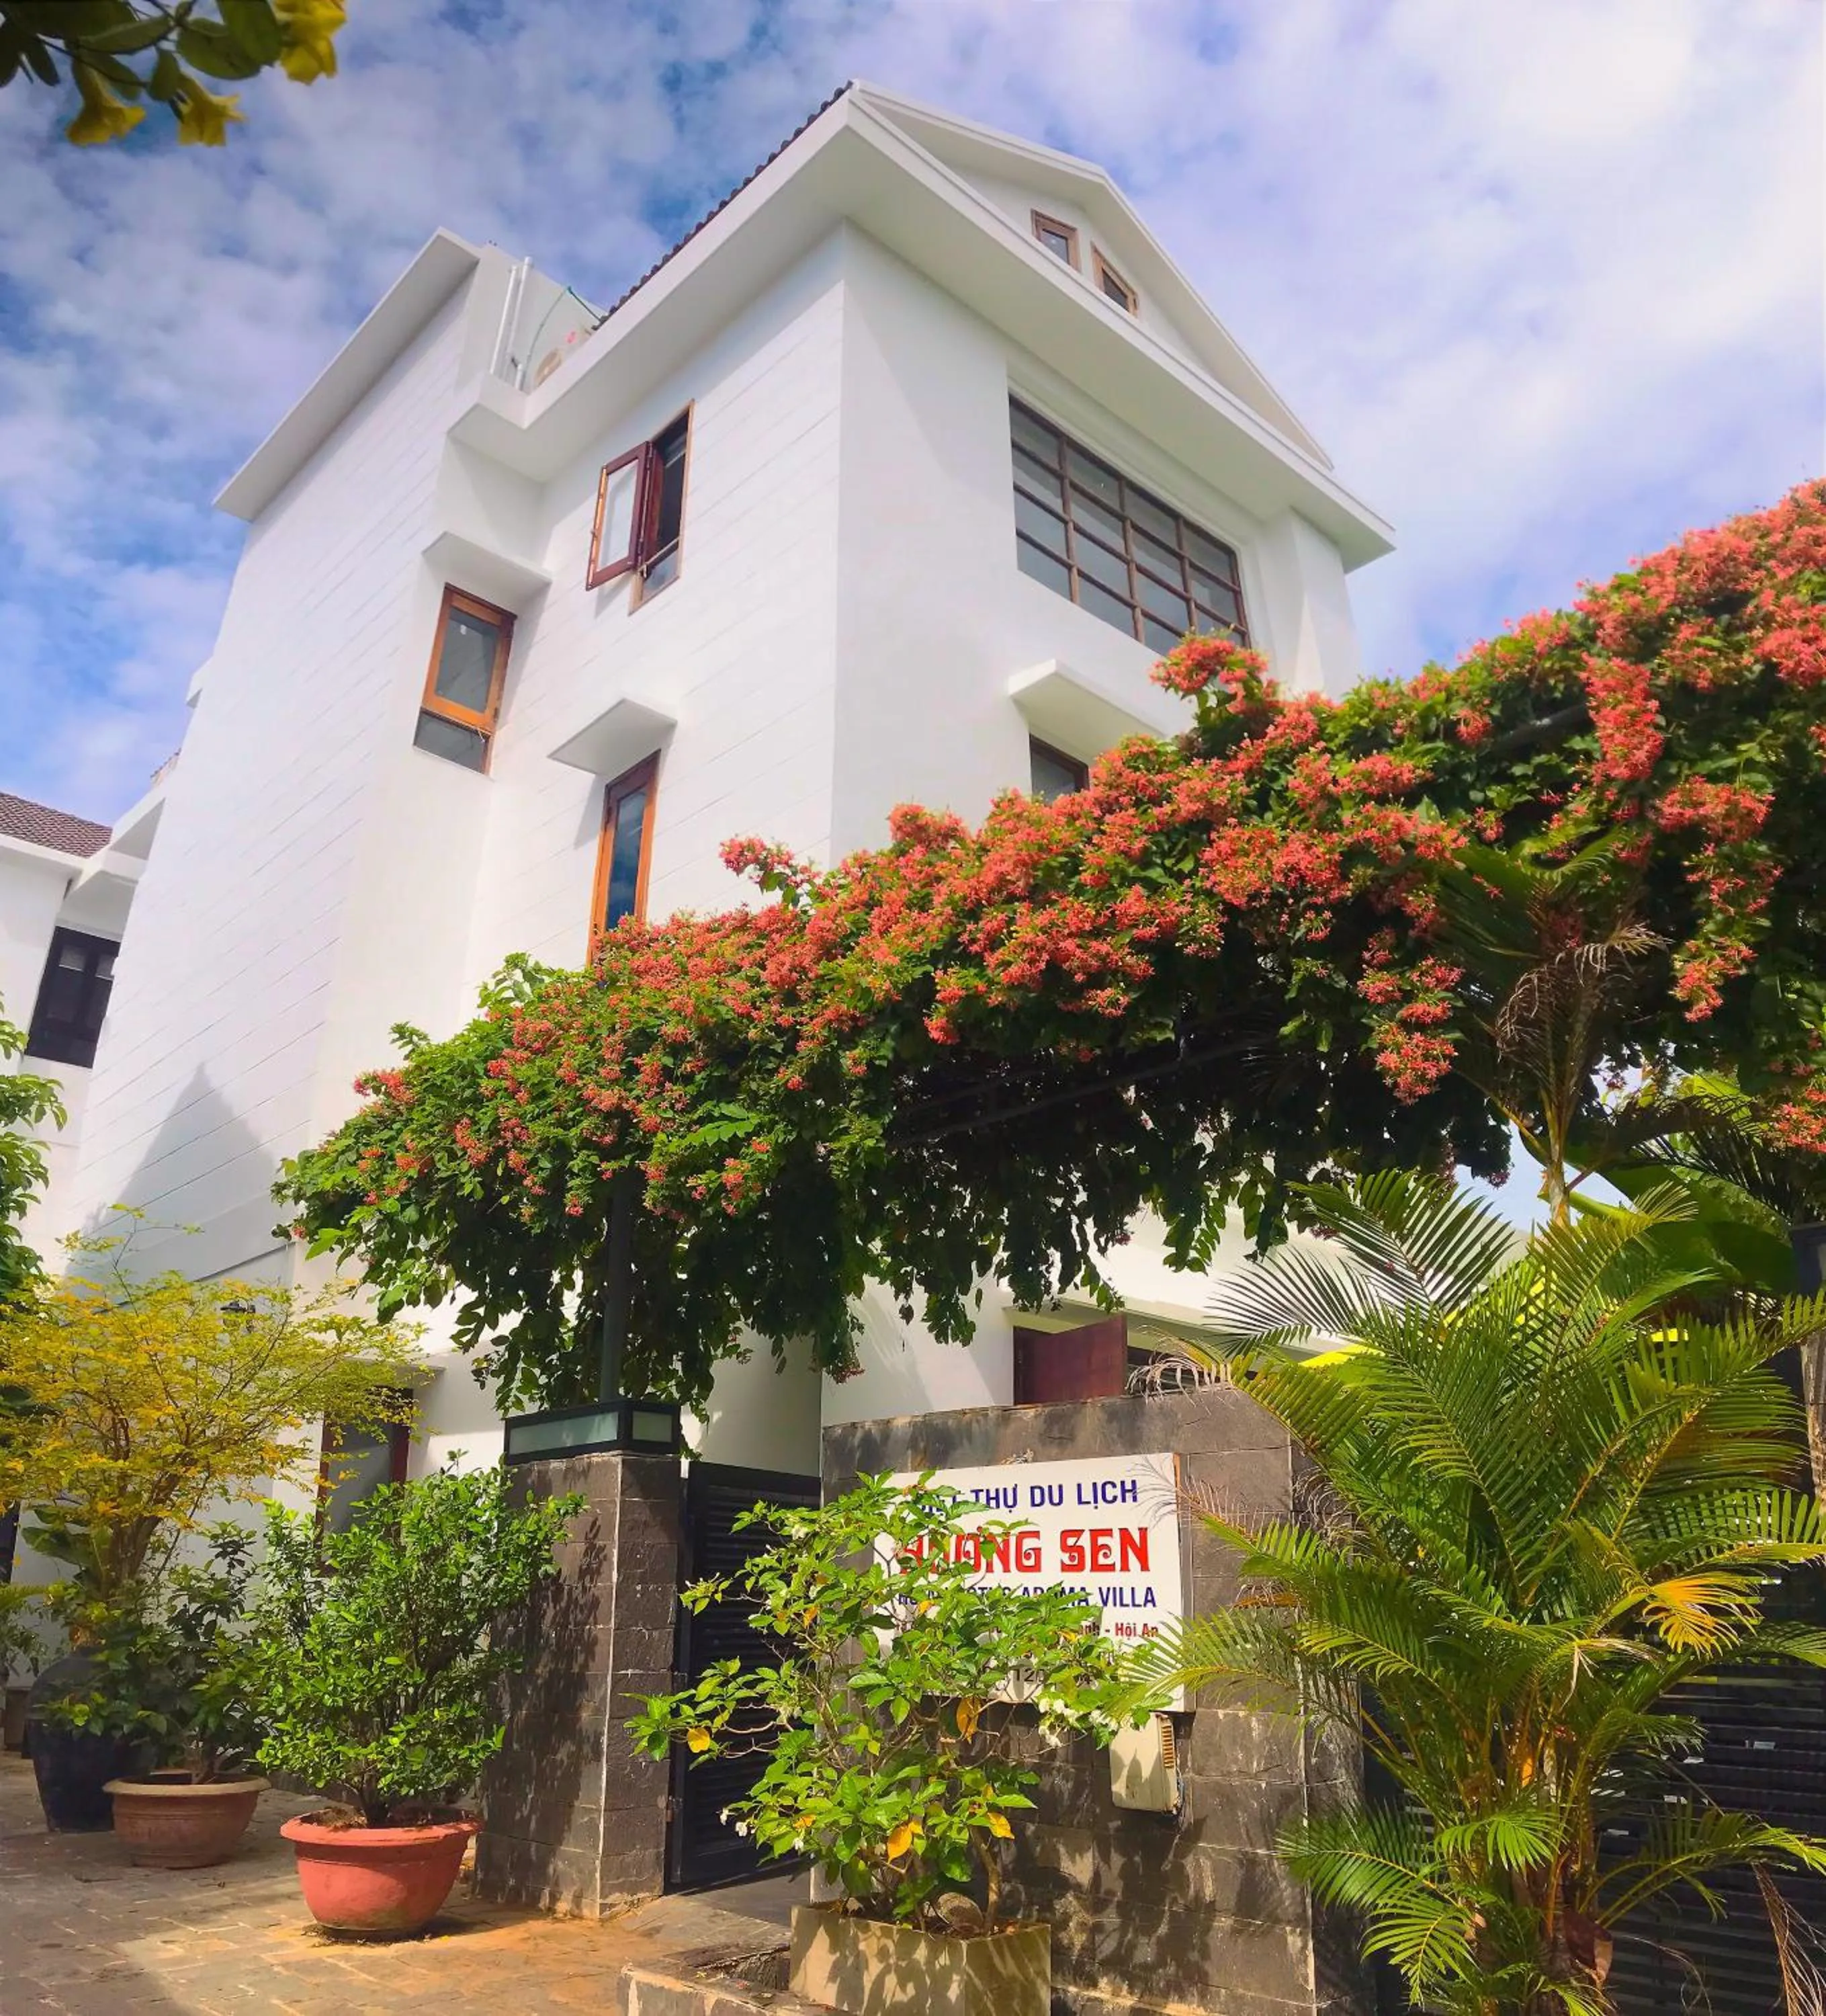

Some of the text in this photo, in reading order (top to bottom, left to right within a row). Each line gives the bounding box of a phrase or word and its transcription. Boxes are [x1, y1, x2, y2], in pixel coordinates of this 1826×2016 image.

[1029, 1483, 1063, 1507] DU
[1076, 1479, 1137, 1510] LỊCH
[1059, 1527, 1151, 1573] SEN
[1022, 1587, 1090, 1607] ARMA
[1098, 1587, 1157, 1607] VILLA
[1115, 1622, 1136, 1640] Hội
